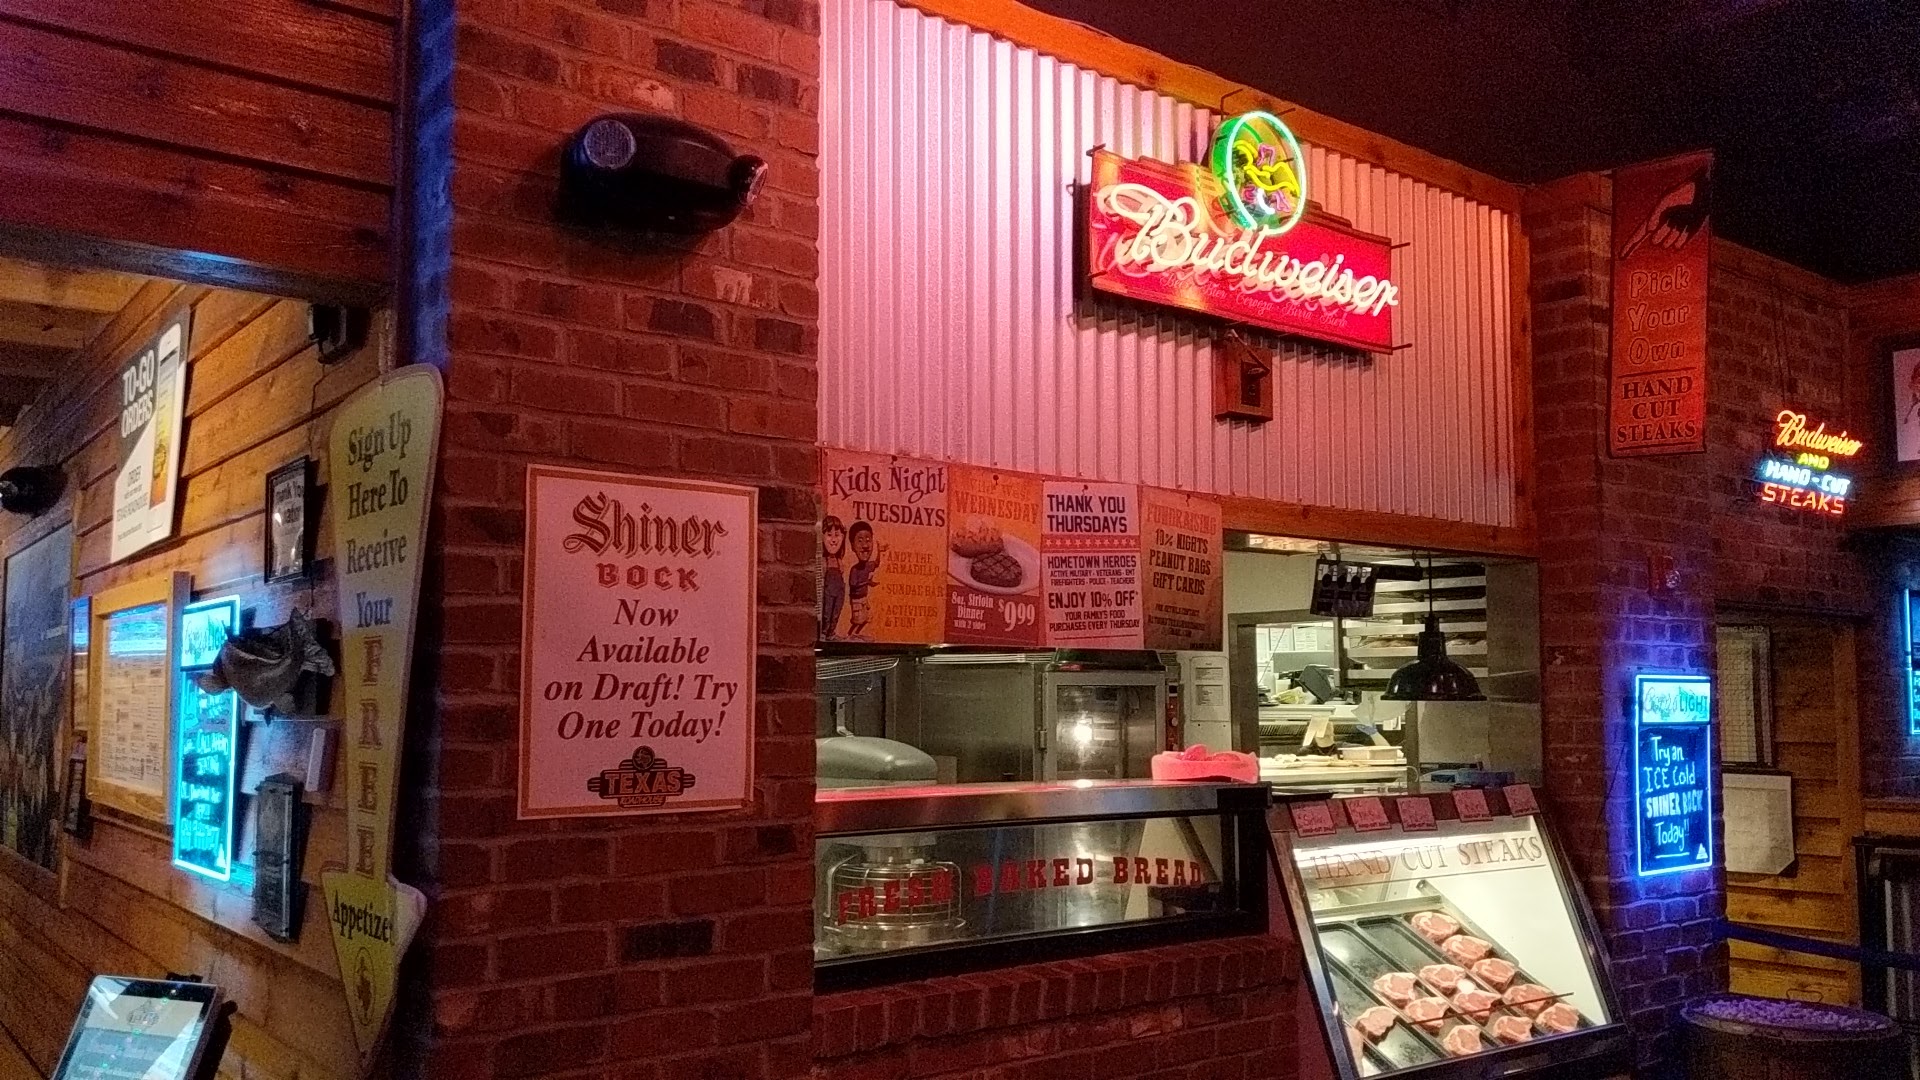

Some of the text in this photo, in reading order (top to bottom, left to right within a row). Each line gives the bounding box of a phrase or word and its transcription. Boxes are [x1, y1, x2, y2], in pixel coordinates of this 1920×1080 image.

[1097, 183, 1398, 316] Budweiser
[1630, 266, 1689, 298] Pick
[1627, 303, 1689, 332] Your
[1629, 338, 1684, 365] Own
[122, 349, 155, 406] TO-GO
[1622, 376, 1693, 400] HAND
[121, 389, 154, 439] ORDERS
[1632, 399, 1681, 420] CUT
[347, 410, 412, 472] Sign Up
[1617, 420, 1696, 443] STEAKS
[1776, 410, 1863, 456] Budweiser
[1797, 453, 1830, 470] AND
[347, 481, 386, 520] Here
[390, 469, 409, 507] To
[829, 466, 945, 504] Kids Night
[1762, 482, 1845, 514] STEAKS
[853, 500, 946, 527] TUESDAYS
[955, 490, 1039, 525] WEDNESDAY
[1047, 494, 1126, 514] THANK YOU
[563, 491, 728, 559] Shiner
[1047, 515, 1127, 533] THURSDAYS
[1147, 503, 1217, 536] FUNDRAISING
[346, 528, 407, 575] Receive
[1155, 528, 1208, 554] 10% NIGHTS
[885, 563, 940, 576] ARMADILLO
[886, 552, 914, 563] ANDY
[1047, 555, 1137, 569] HOMETOWN HEROES
[1149, 549, 1211, 576] PEANUT BAGS
[596, 562, 701, 592] BOCK
[1050, 568, 1135, 578] ACTIVE MILITARY VETERANS EMT
[1089, 577, 1106, 585] POLICE
[1110, 577, 1135, 585] TEACHERS
[1153, 571, 1206, 595] GIFT CARDS
[356, 592, 393, 629] Your
[613, 598, 679, 627] Now
[886, 605, 938, 618] ACTIVITIES
[957, 605, 985, 621] Dinner
[968, 593, 994, 609] Sirloin
[1048, 592, 1086, 609] ENJOY
[1091, 591, 1112, 608] 10%
[1049, 621, 1086, 632] PURCHASES
[1088, 620, 1108, 630] EVERY
[1110, 619, 1140, 629] THURSDAY
[1065, 611, 1081, 621] YOUR
[1110, 609, 1126, 619] FOOD
[577, 635, 710, 664] Available
[544, 673, 738, 707] on Draft! Try
[558, 710, 727, 744] One Today!
[1651, 736, 1685, 767] Try an
[604, 770, 682, 796] TEXAS
[1643, 761, 1696, 793] ICE Cold
[1646, 790, 1704, 819] SHINER BOCK
[1310, 835, 1543, 881] HAND CUT STEAKS
[837, 855, 1202, 926] FRESH BAKED BREAD
